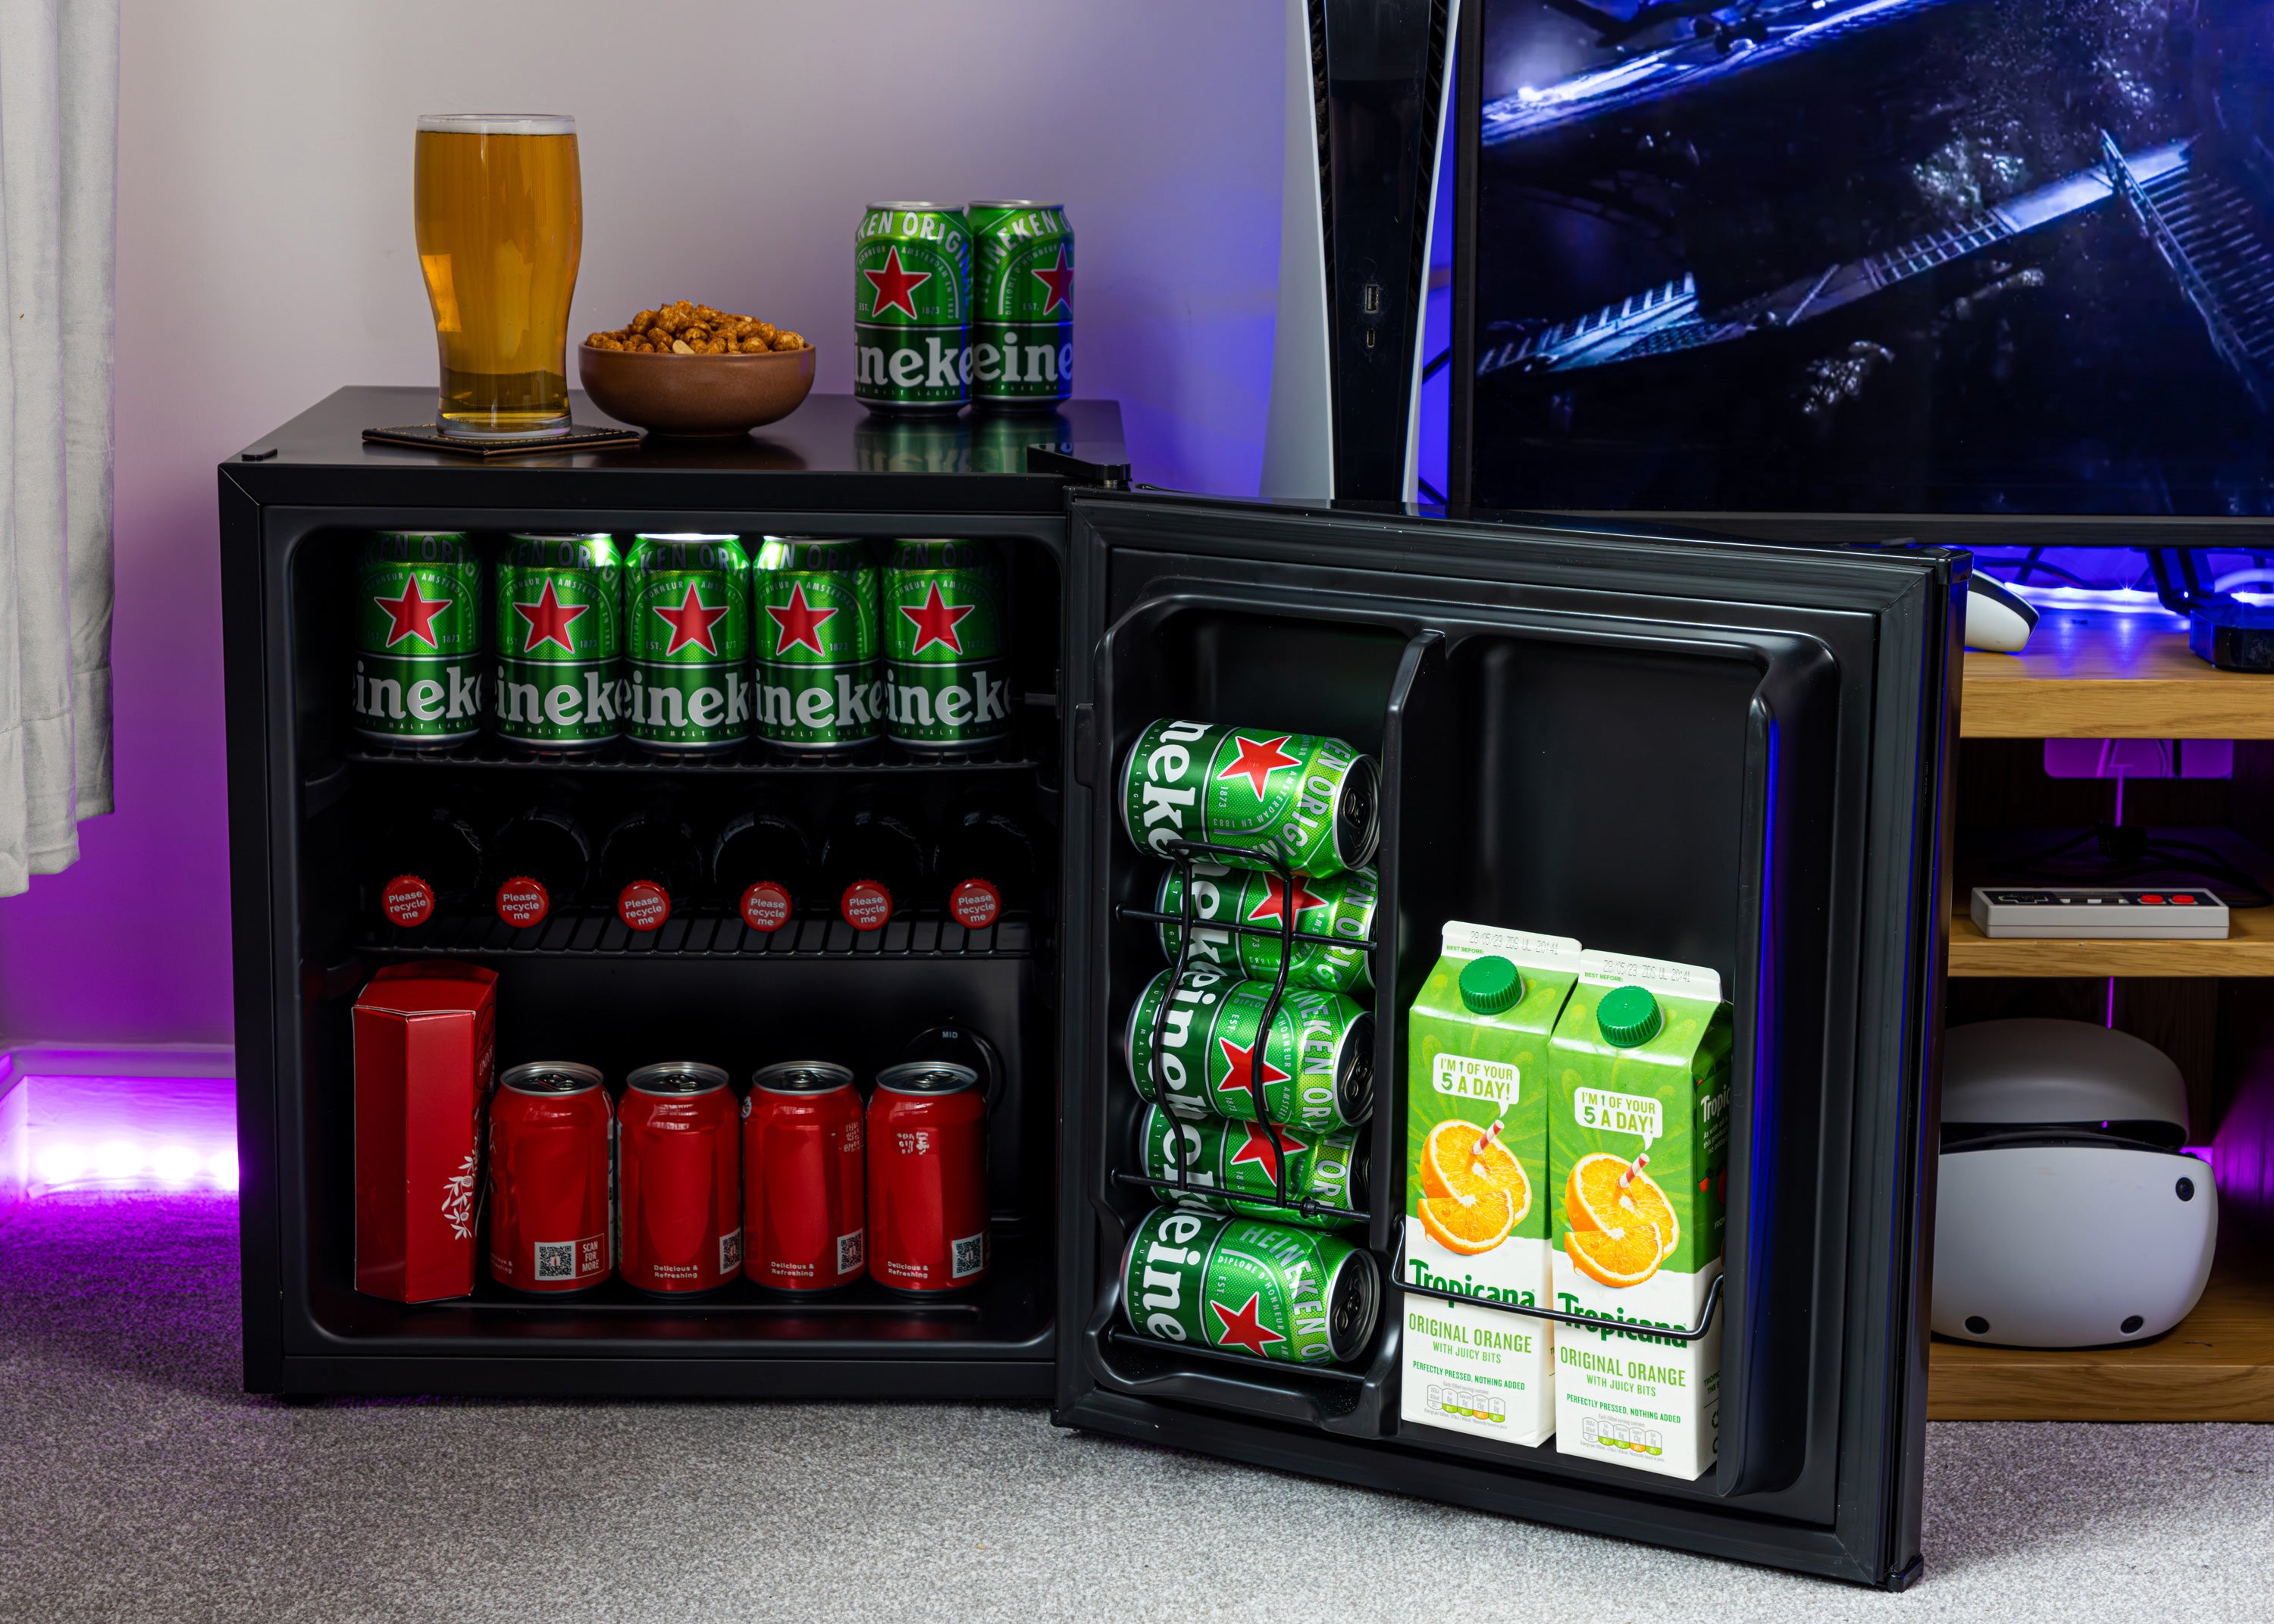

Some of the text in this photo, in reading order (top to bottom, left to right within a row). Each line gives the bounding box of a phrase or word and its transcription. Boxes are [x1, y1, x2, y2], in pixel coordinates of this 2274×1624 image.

[1213, 769, 1298, 828] AMSTERDAM EN 1883
[1217, 785, 1229, 809] 1873
[388, 890, 423, 903] Please
[503, 893, 537, 903] Please
[625, 896, 659, 909] Please
[849, 896, 883, 907] Please
[957, 893, 992, 906] Please
[390, 899, 426, 913] recycle
[502, 901, 540, 912] recycle
[750, 898, 785, 909] Please
[849, 904, 885, 916] recycle
[958, 902, 995, 915] recycle
[402, 910, 418, 920] me
[625, 905, 662, 918] recycle
[748, 907, 785, 919] recycle
[969, 913, 986, 922] me
[637, 916, 655, 925] me
[757, 917, 774, 926] me
[860, 915, 877, 923] me
[1599, 974, 1624, 982] BEFORE:
[1226, 1013, 1240, 1033] EST.
[942, 1031, 958, 1039] MID
[1440, 1058, 1513, 1081] I'M 1 OF YOUR
[1441, 1072, 1511, 1100] 5 A DAY!
[1581, 1091, 1655, 1115] I'M 1 OF YOUR
[1583, 1106, 1654, 1134] 5 A DAY!
[582, 1241, 598, 1253] SCAN
[585, 1251, 597, 1263] FOR
[1135, 1239, 1149, 1275] PURE
[582, 1259, 600, 1272] MORE
[888, 1261, 921, 1271] Delicious
[772, 1269, 814, 1277] Refreshing
[888, 1268, 929, 1279] Refreshing
[1216, 1275, 1226, 1297] EST.
[1239, 1225, 1326, 1336] HEINEKEN
[1217, 1256, 1285, 1331] DIPLOME D'HONNEUR
[1408, 1313, 1533, 1353] ORIGINAL ORANGE
[1433, 1341, 1502, 1364] WITH JUICY BITS
[1561, 1346, 1686, 1388] ORIGINAL ORANGE
[1413, 1360, 1526, 1391] PERFECTLY PRESSED, NOTHING ADDED
[1586, 1374, 1656, 1397] WITH JUICY BITS
[1567, 1393, 1681, 1424] PERFECTLY PRESSED, NOTHING ADDED
